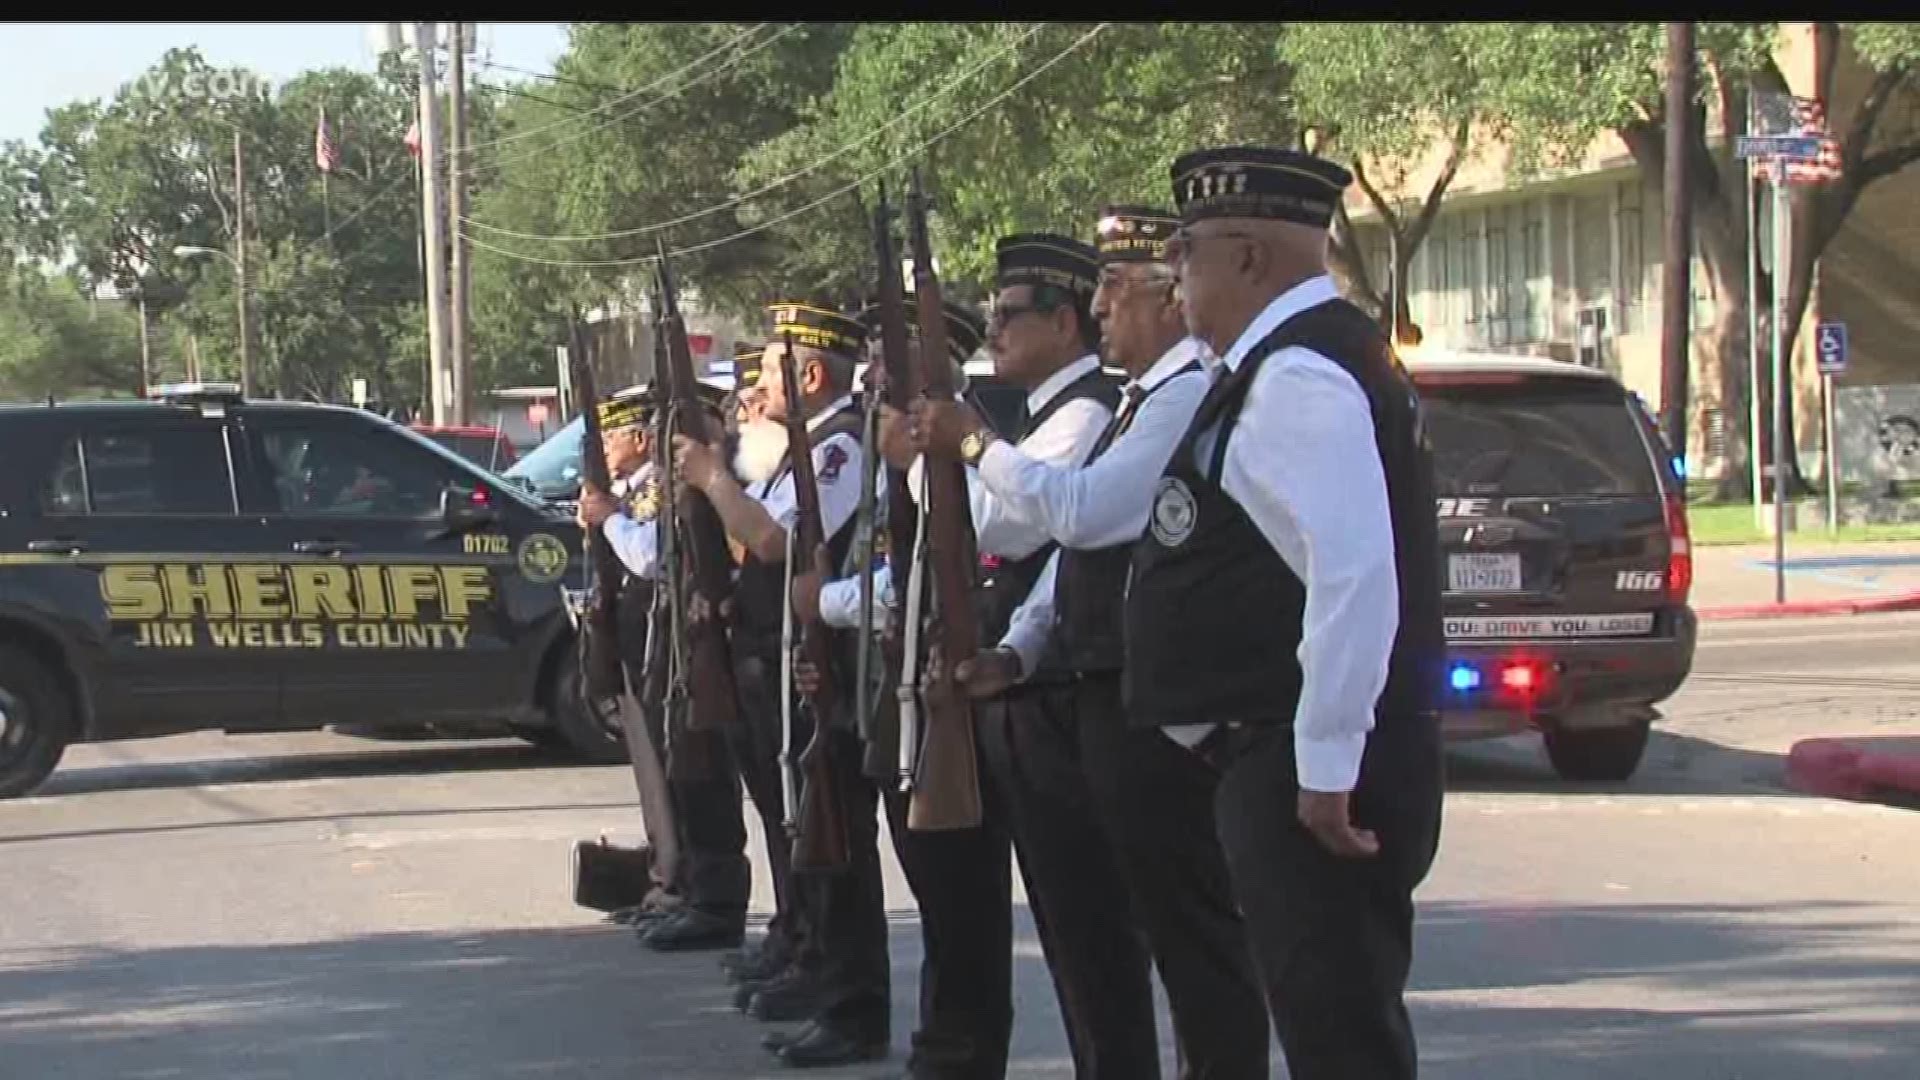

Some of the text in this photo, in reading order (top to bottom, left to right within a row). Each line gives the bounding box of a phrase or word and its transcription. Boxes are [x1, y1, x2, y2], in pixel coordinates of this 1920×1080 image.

[463, 534, 509, 553] 01702
[1615, 570, 1663, 590] 166
[102, 564, 493, 620] SHERIFF
[134, 622, 469, 648] JIM WELLS COUNTY
